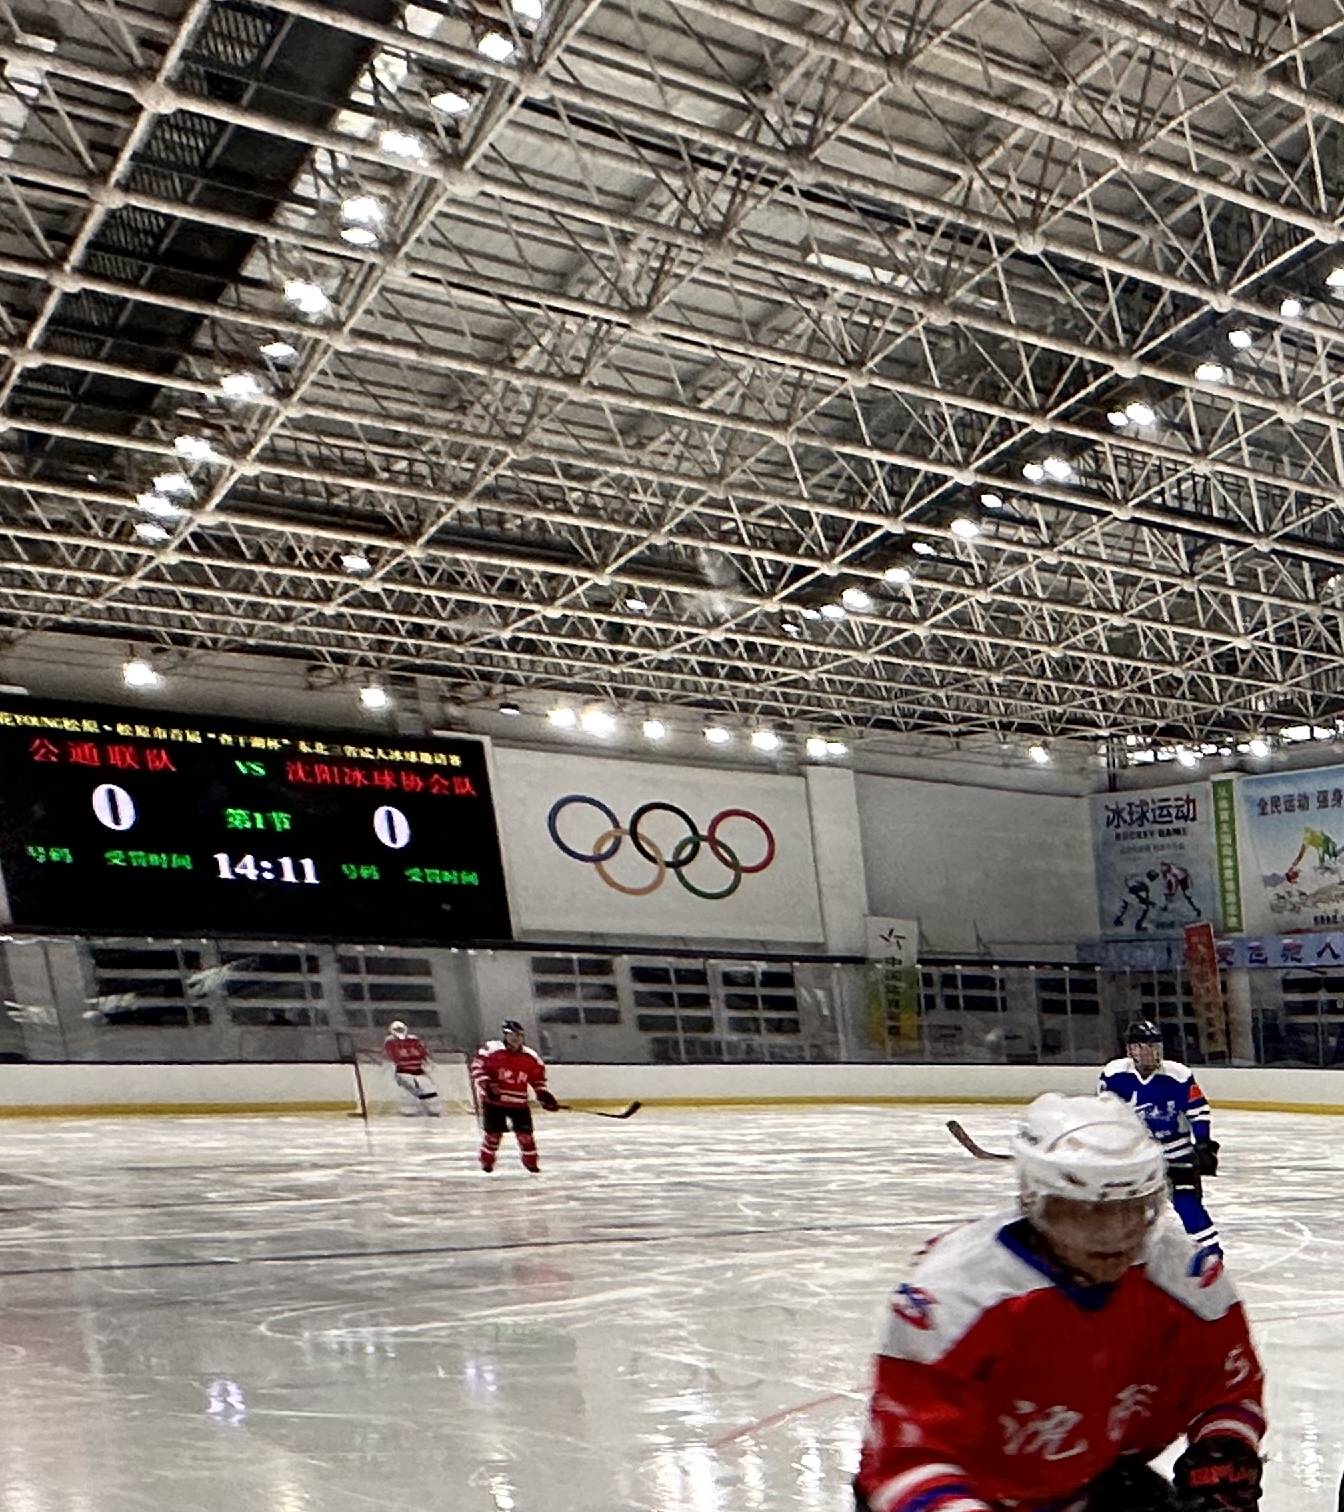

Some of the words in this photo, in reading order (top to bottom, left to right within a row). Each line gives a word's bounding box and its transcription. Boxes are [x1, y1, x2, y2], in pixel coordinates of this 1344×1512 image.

[234, 759, 266, 777] VS
[92, 783, 136, 831] 0
[1105, 793, 1198, 829] 冰球运动
[373, 805, 411, 849] 0
[213, 852, 320, 884] 14:11
